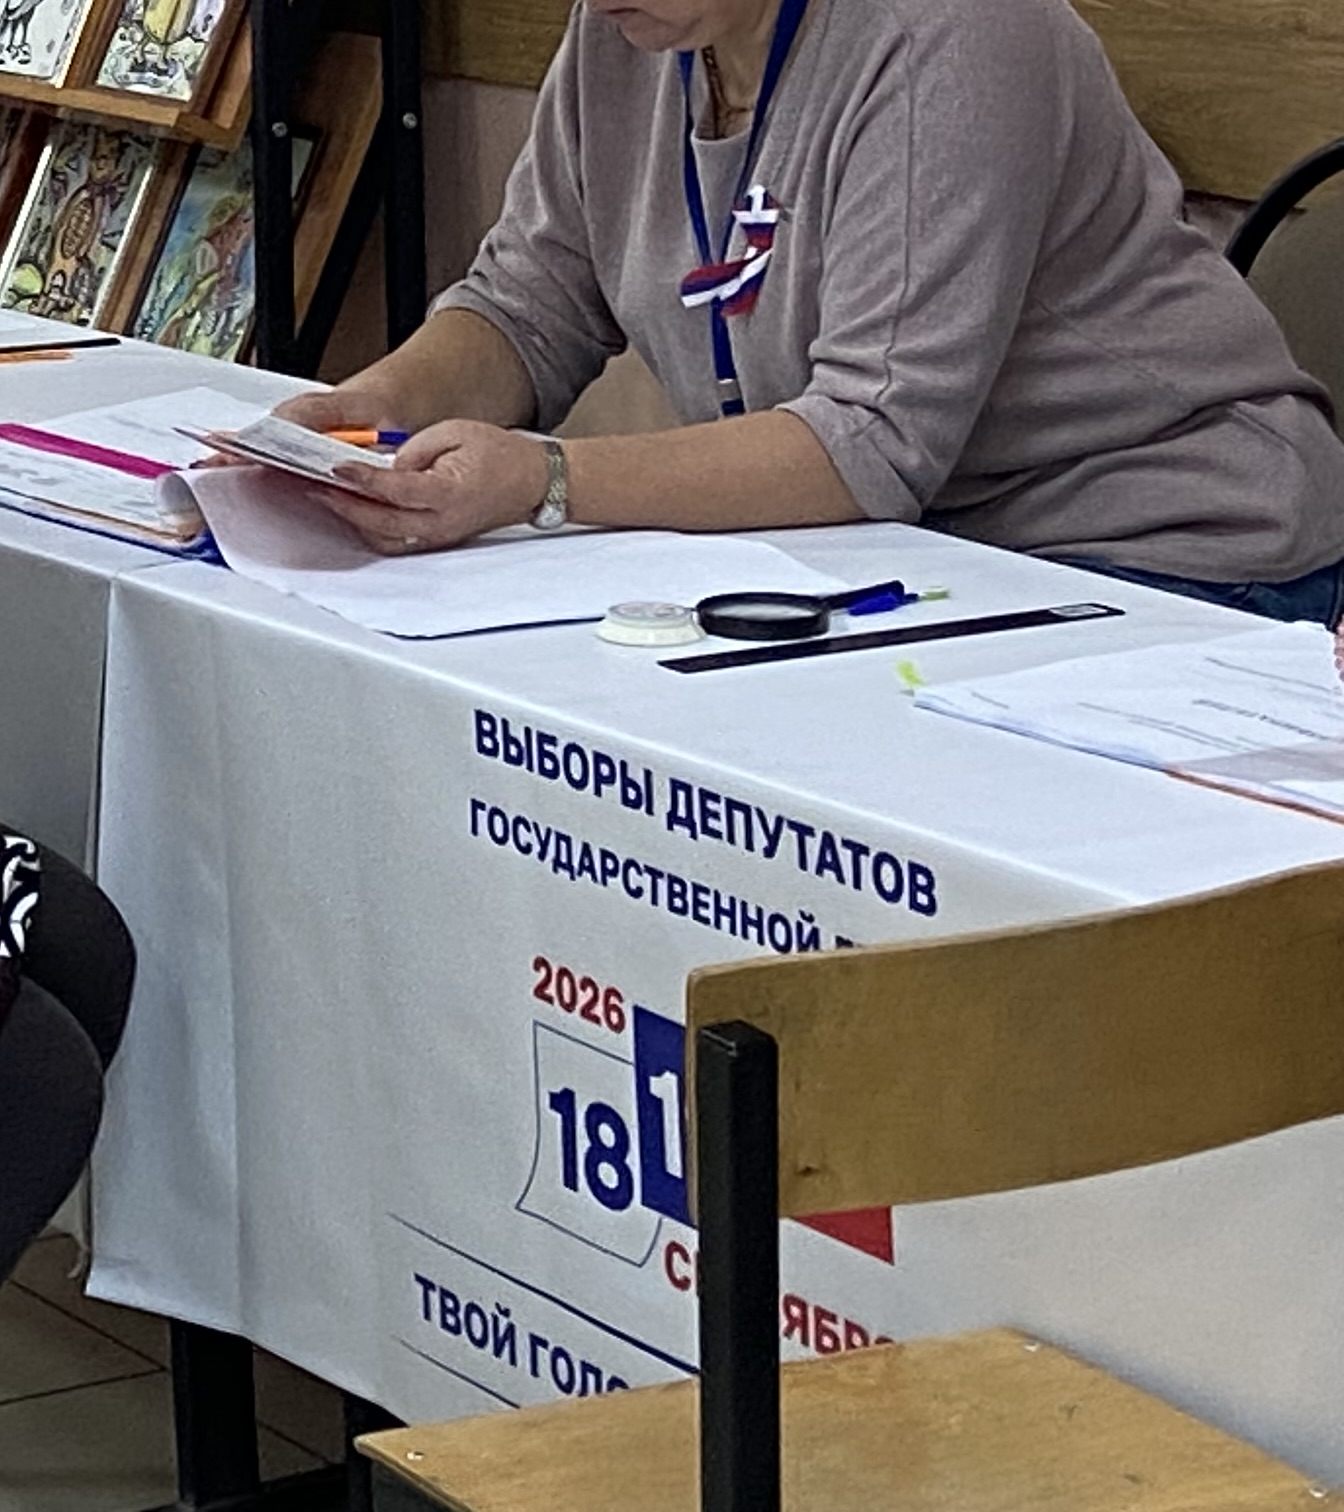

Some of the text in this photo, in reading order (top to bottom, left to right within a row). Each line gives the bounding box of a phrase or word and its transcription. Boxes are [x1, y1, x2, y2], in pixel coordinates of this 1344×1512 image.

[474, 707, 938, 917] ВЫБОРЫ ДЕПУТАТОВ
[469, 798, 820, 954] ГОСУДАРСТВЕННОЙ
[532, 956, 626, 1034] 2026
[548, 1087, 637, 1213] 18
[414, 1273, 517, 1368] ТВОЙ
